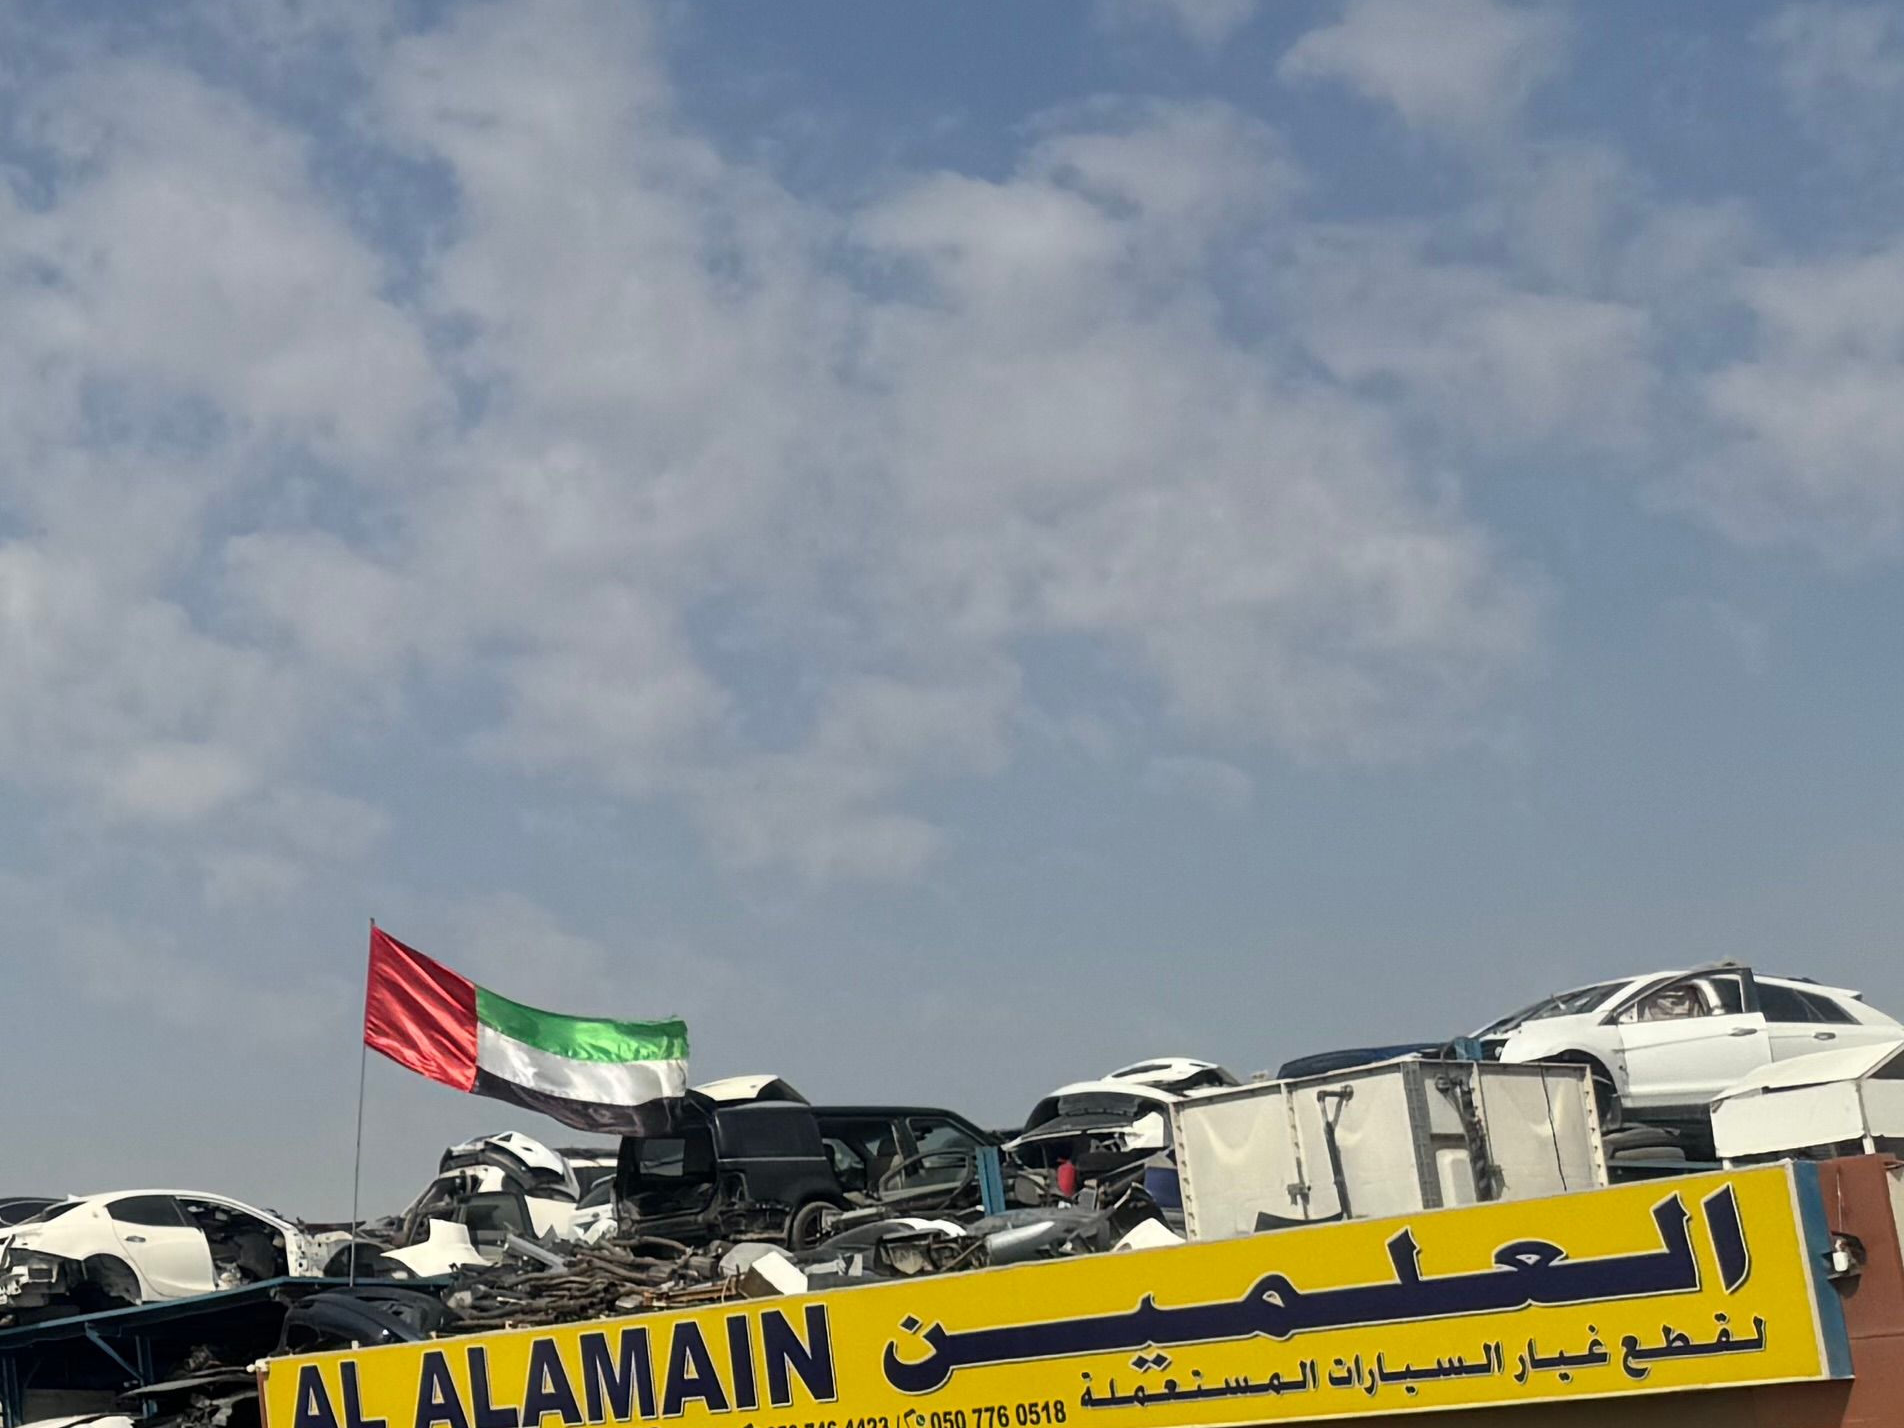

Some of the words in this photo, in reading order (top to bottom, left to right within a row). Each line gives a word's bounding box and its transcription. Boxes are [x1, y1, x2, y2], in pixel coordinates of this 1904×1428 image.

[882, 1183, 1754, 1393] العلمين
[1329, 1340, 1505, 1397] السيارات
[1515, 1325, 1609, 1385] غيار
[1622, 1312, 1767, 1380] لقطع
[1079, 1357, 1318, 1411] المستعملة
[972, 1406, 1009, 1428] 776
[1016, 1400, 1067, 1426] 0518
